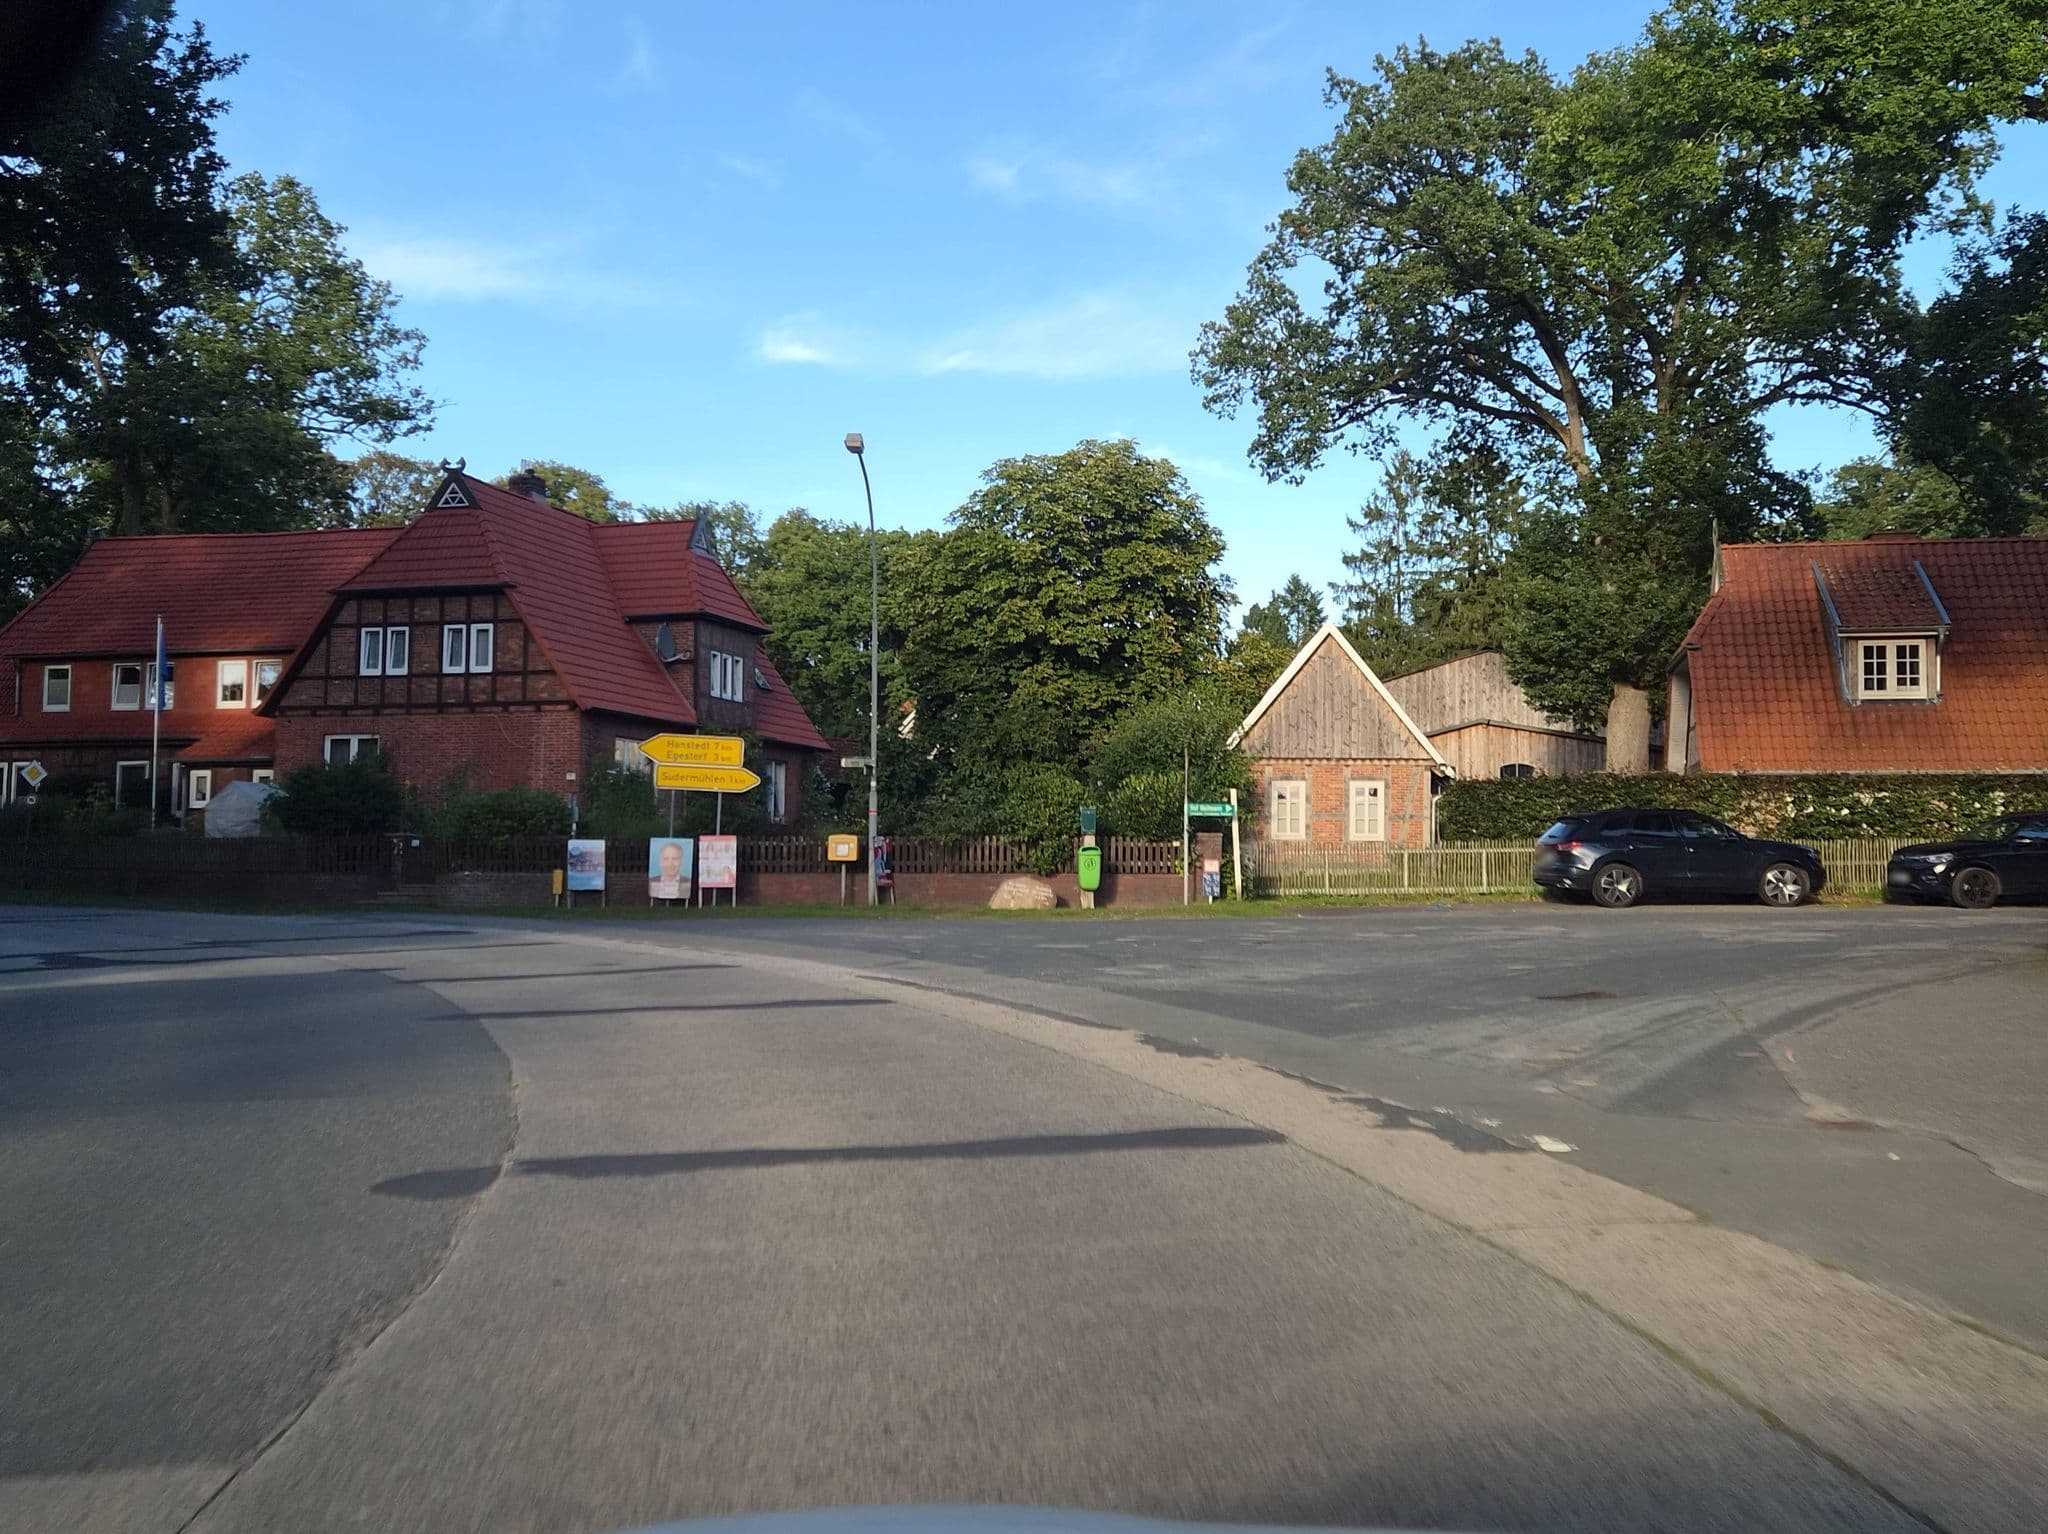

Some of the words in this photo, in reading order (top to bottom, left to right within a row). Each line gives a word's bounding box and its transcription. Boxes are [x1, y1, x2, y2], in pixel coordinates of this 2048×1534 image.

[667, 740, 710, 750] Hanstedt
[714, 742, 720, 750] 7
[666, 750, 707, 761] Egestorf
